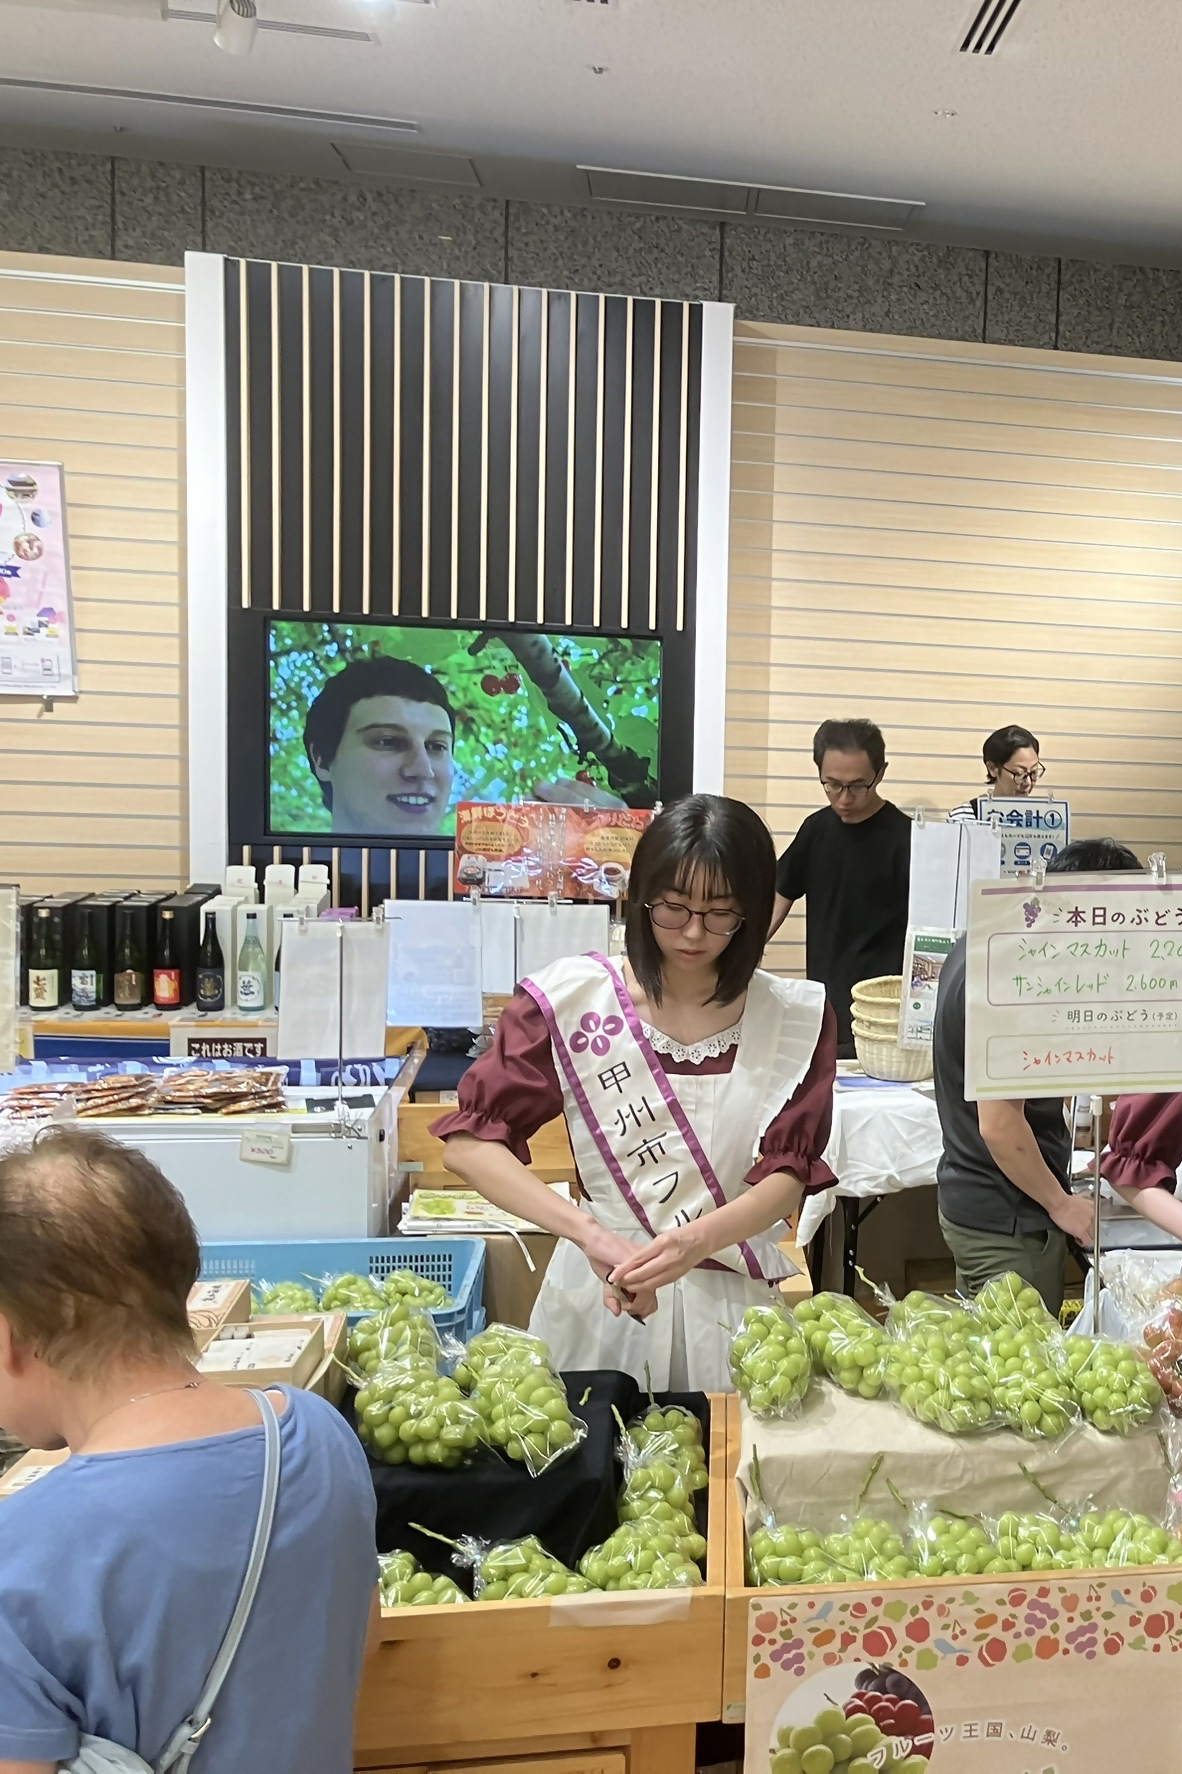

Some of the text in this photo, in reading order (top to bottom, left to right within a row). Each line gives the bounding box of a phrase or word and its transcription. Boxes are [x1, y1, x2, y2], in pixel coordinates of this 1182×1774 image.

[1012, 973, 1110, 997] サンシャインレッド
[190, 1041, 265, 1058] これはお酒です
[1022, 1046, 1115, 1071] シャインマスカット
[597, 1060, 703, 1228] 甲州市フル
[868, 1721, 1069, 1769] フルーツ王国、山梨。
